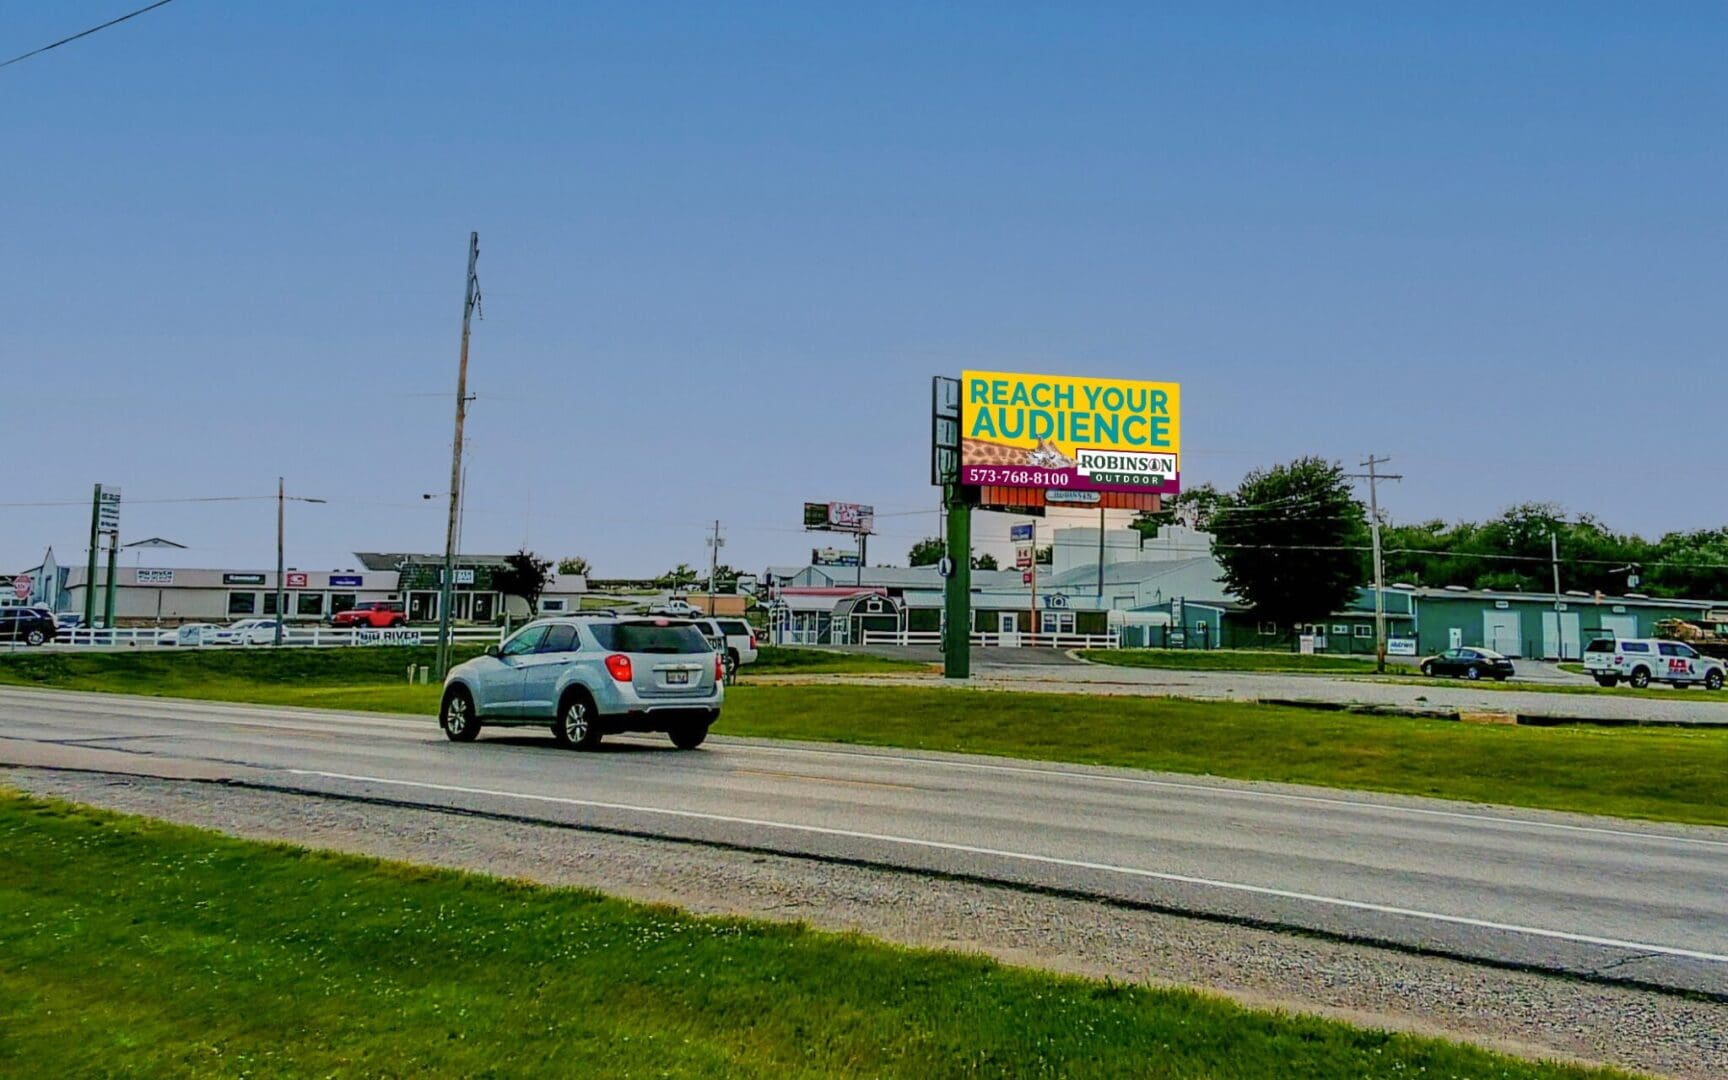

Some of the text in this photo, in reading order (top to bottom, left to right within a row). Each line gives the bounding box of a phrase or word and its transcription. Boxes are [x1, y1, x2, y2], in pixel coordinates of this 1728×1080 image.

[970, 379, 1169, 415] REACH YOUR
[971, 406, 1171, 447] AUDIENCE
[1081, 454, 1173, 472] ROBINSON
[970, 468, 1069, 486] 573-768-8100
[1095, 474, 1159, 485] OUTDOOR
[383, 631, 419, 640] RIVER
